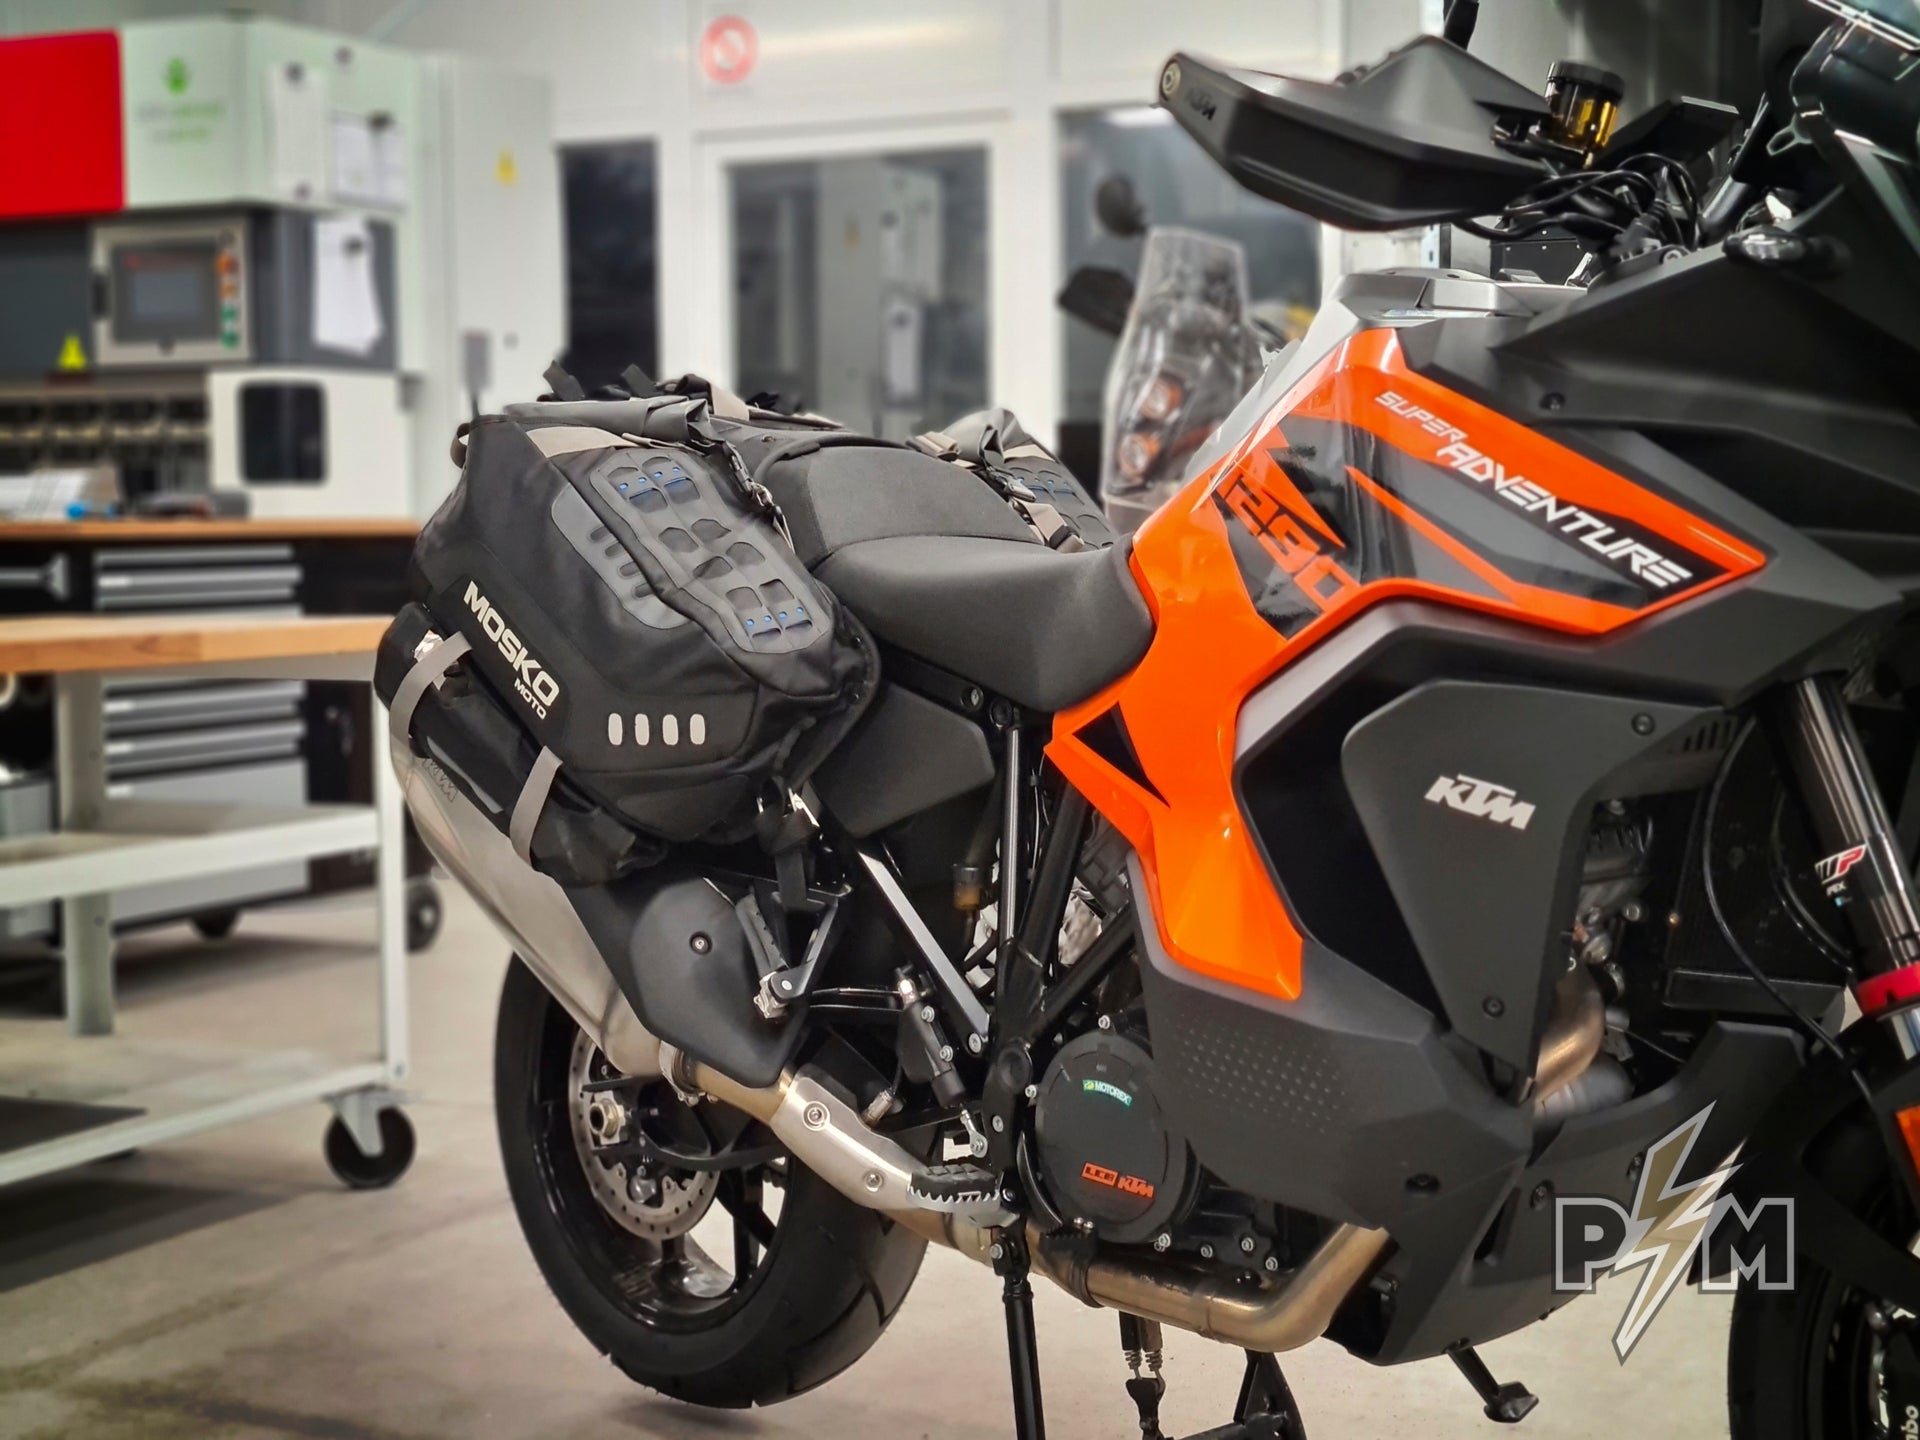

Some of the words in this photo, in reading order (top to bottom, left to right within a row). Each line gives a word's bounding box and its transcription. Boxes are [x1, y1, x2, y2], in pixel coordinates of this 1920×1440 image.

[1375, 391, 1468, 442] SUPER
[1436, 442, 1693, 588] ADVENTURE
[463, 580, 560, 707] MOSKO
[514, 677, 547, 720] MOTO
[1424, 773, 1536, 830] KTM
[1814, 843, 1867, 885] WP
[1094, 1080, 1130, 1105] MOTOREX
[1117, 1175, 1154, 1198] KTM
